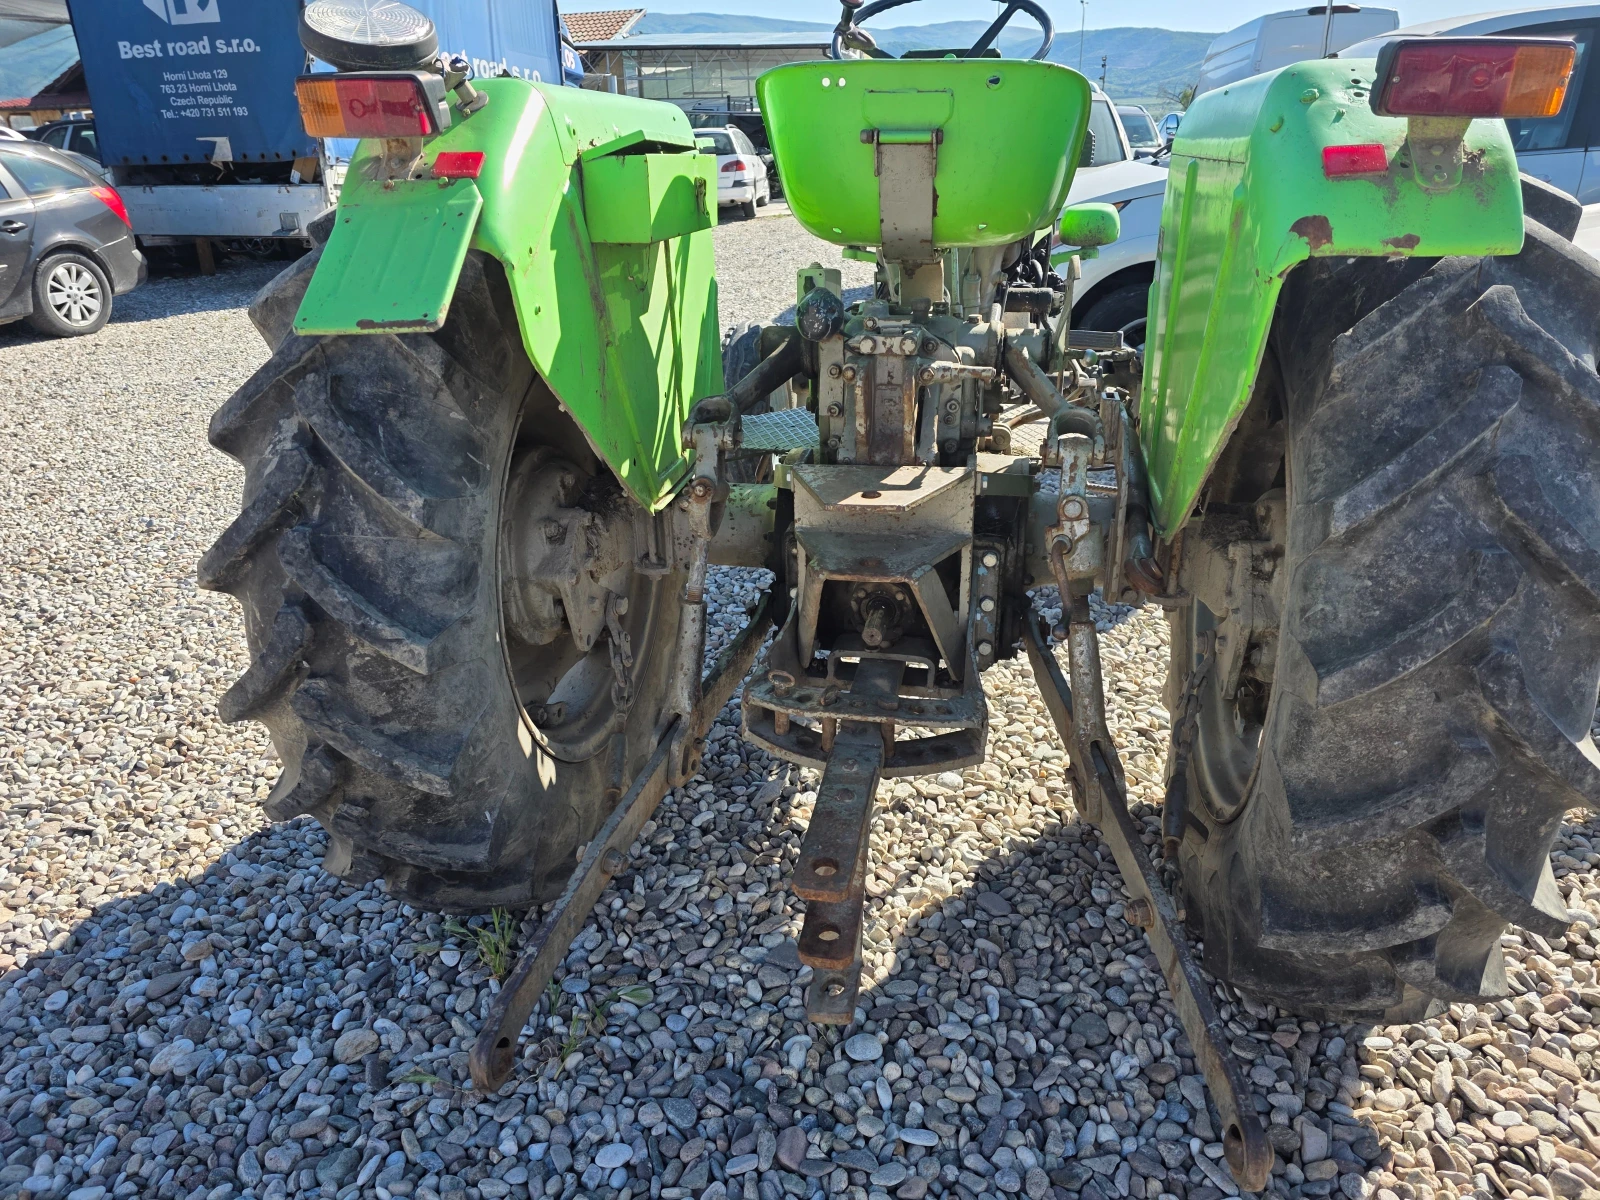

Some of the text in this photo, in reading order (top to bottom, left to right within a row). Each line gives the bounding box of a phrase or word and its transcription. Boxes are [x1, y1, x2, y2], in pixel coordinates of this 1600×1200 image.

[117, 35, 261, 59] Best road s.r.o.
[187, 69, 212, 80] Lhota
[213, 69, 228, 79] 129
[472, 57, 508, 79] road
[160, 84, 175, 94] 763
[177, 84, 188, 93] 23
[213, 81, 237, 92] Lhota
[170, 95, 233, 106] Czech Republic
[161, 106, 248, 119] Tel.: +420 731 511 193
